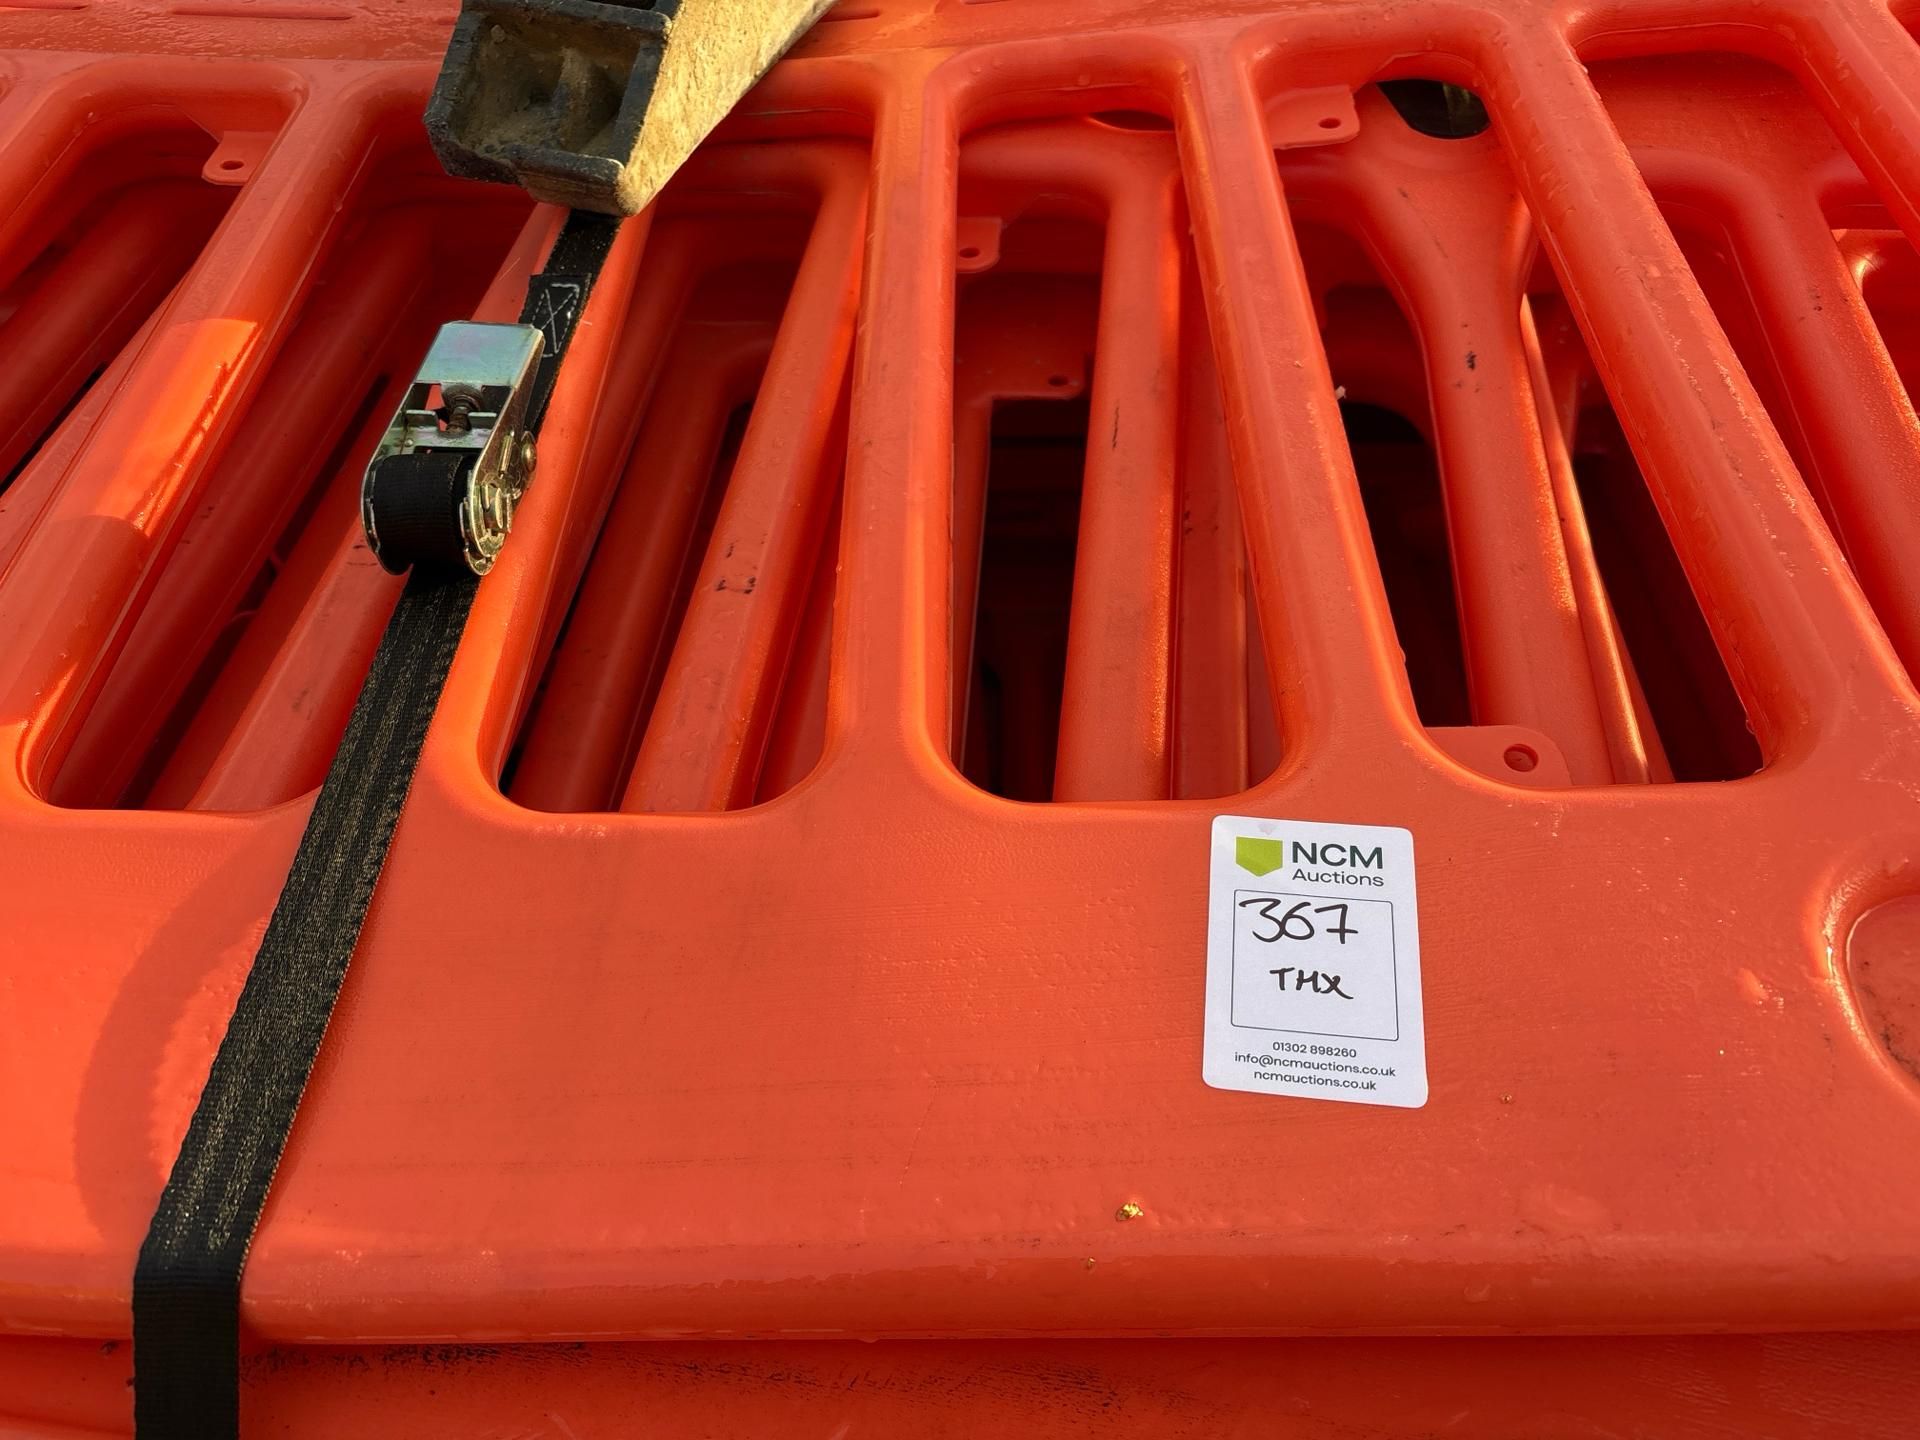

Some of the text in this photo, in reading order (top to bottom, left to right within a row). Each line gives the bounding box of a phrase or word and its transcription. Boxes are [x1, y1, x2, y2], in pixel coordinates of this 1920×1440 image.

[1292, 841, 1384, 869] NCM
[1292, 868, 1385, 888] Auctions
[1238, 897, 1359, 945] 367
[1269, 967, 1354, 1000] THX
[1272, 1041, 1357, 1058] 01302 898260
[1234, 1052, 1396, 1077] info@ncmauctions.co.uk
[1253, 1071, 1377, 1091] ncmauctions.co.uk
